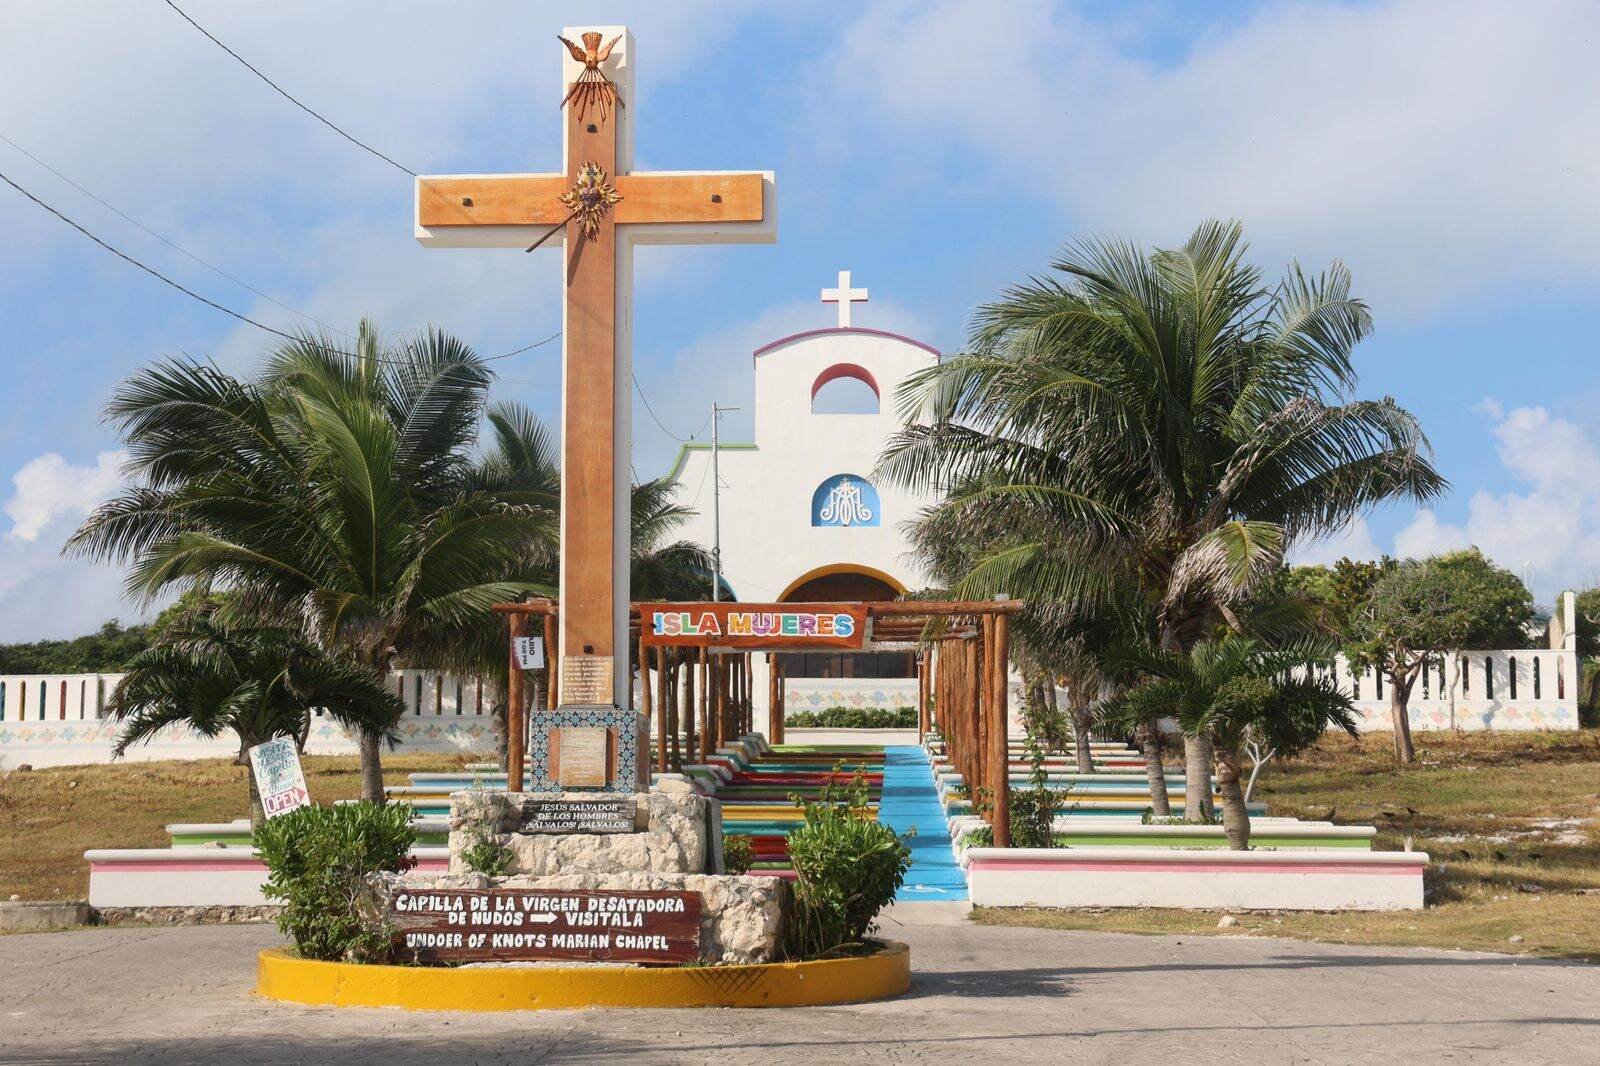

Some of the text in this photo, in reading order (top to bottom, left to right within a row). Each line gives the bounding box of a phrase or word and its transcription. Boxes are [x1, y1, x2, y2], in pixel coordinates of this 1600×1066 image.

[653, 612, 854, 636] ISLA MUJERES
[266, 789, 301, 812] OPEN
[569, 803, 618, 811] SALVADOR
[538, 812, 619, 820] DE LOS HOMBRES
[396, 895, 685, 912] CAPILLA DE LA VIRGEN DESATADORA
[448, 911, 643, 927] DE NUDOS VISITALA
[406, 933, 669, 951] UNDOER OF KNOTS MARIAN CHAPEL
